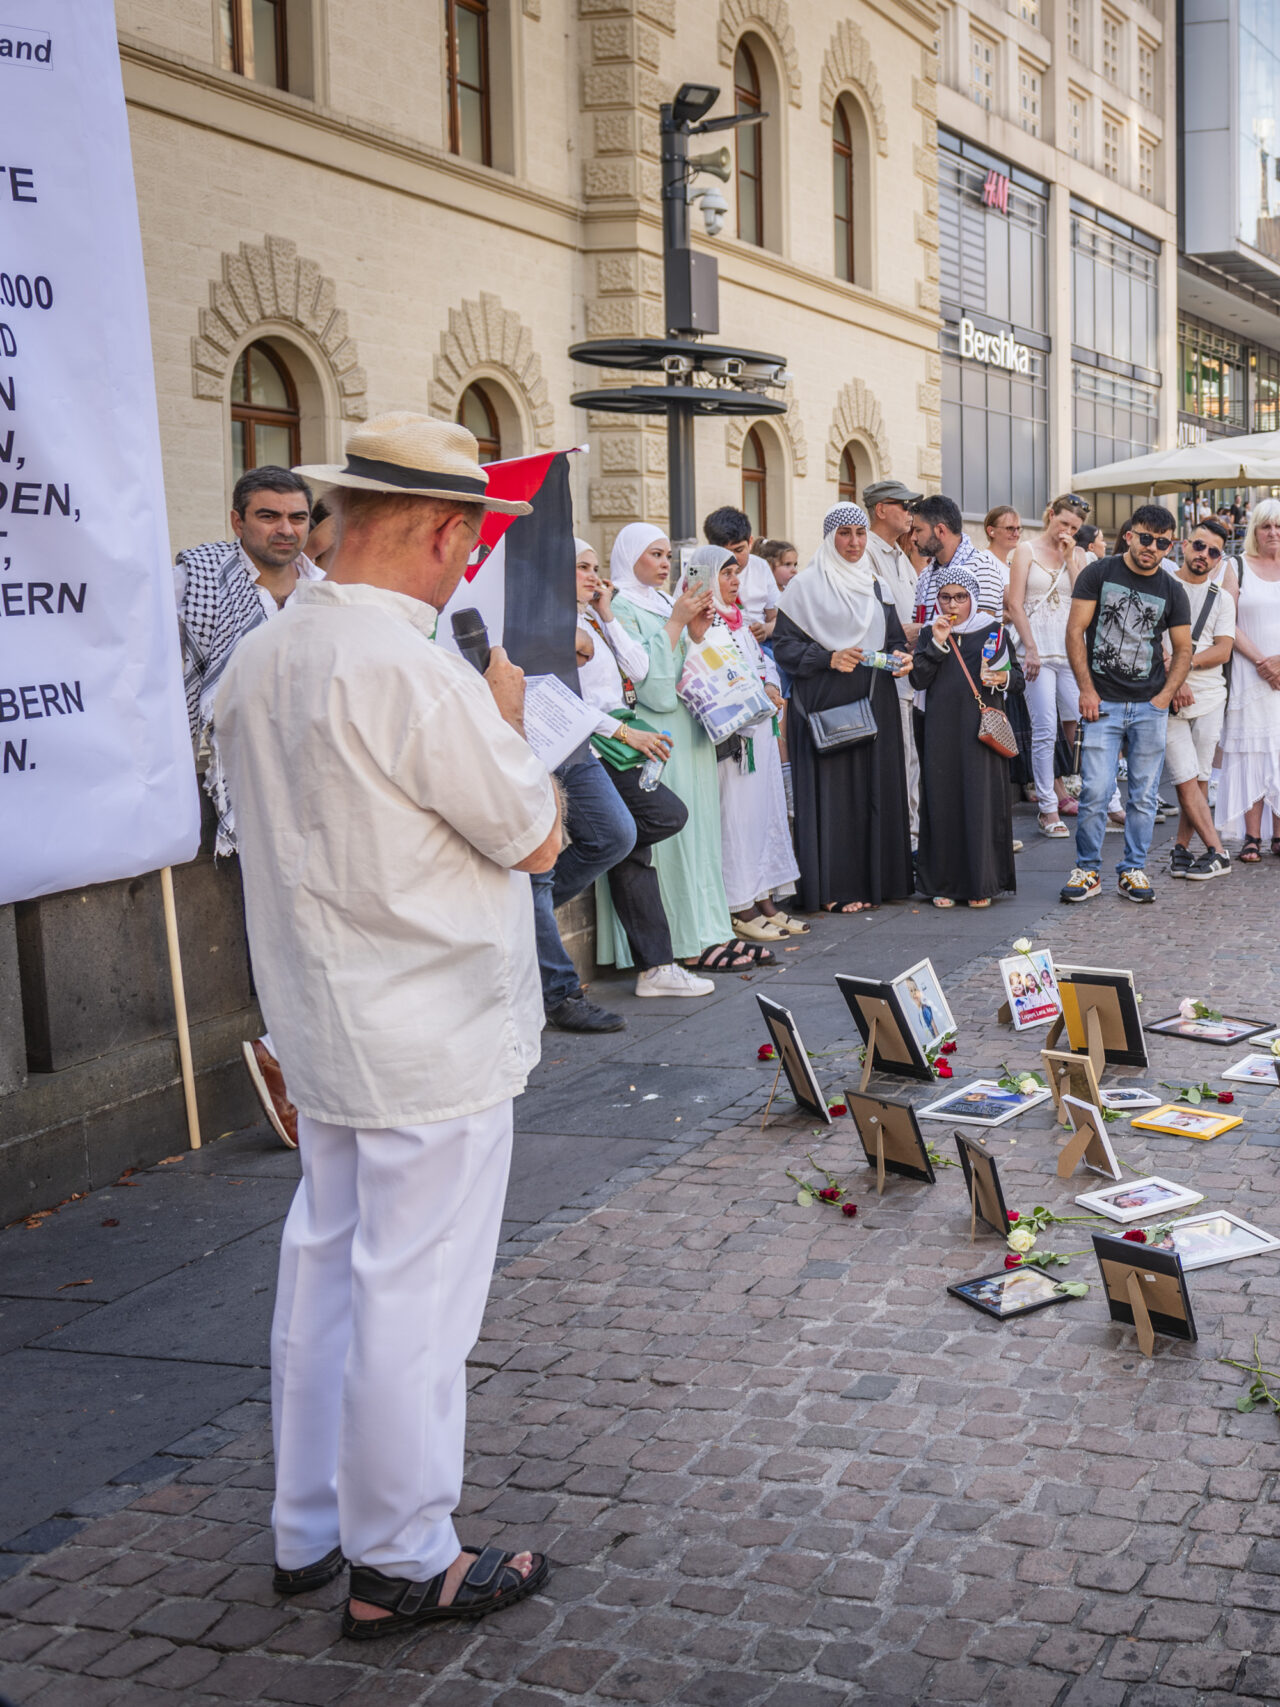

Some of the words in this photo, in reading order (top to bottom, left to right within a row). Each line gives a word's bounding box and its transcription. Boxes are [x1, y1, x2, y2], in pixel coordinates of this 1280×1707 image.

[0, 165, 38, 203] E
[961, 317, 1029, 374] Bershka
[0, 582, 87, 617] ERN
